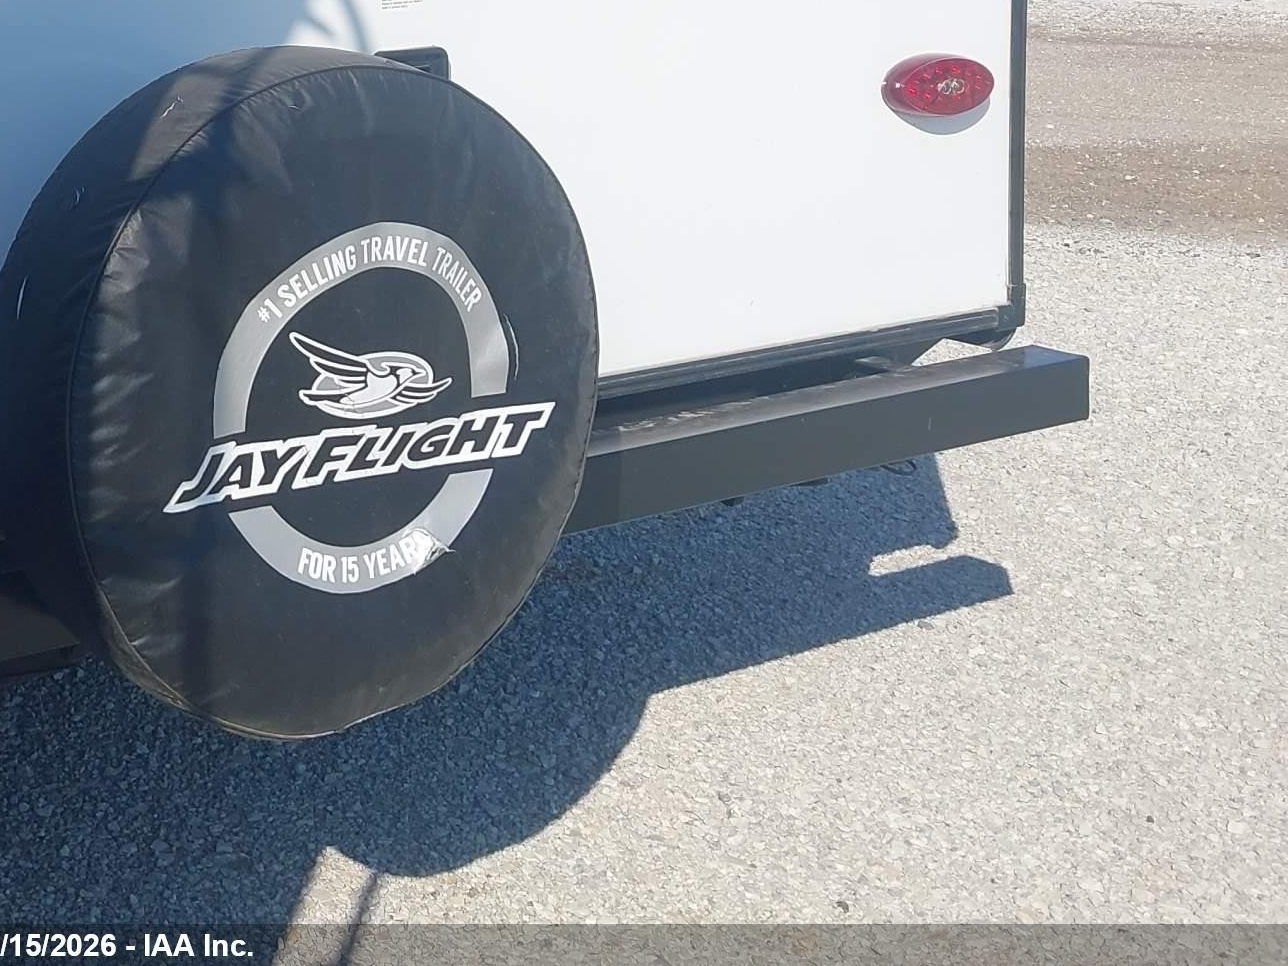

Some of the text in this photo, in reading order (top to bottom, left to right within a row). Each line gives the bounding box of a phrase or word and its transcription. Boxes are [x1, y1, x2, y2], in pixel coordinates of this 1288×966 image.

[257, 235, 483, 323] #1 SELLING TRAVEL TRAILER
[297, 531, 428, 583] FOR 15 YEAR
